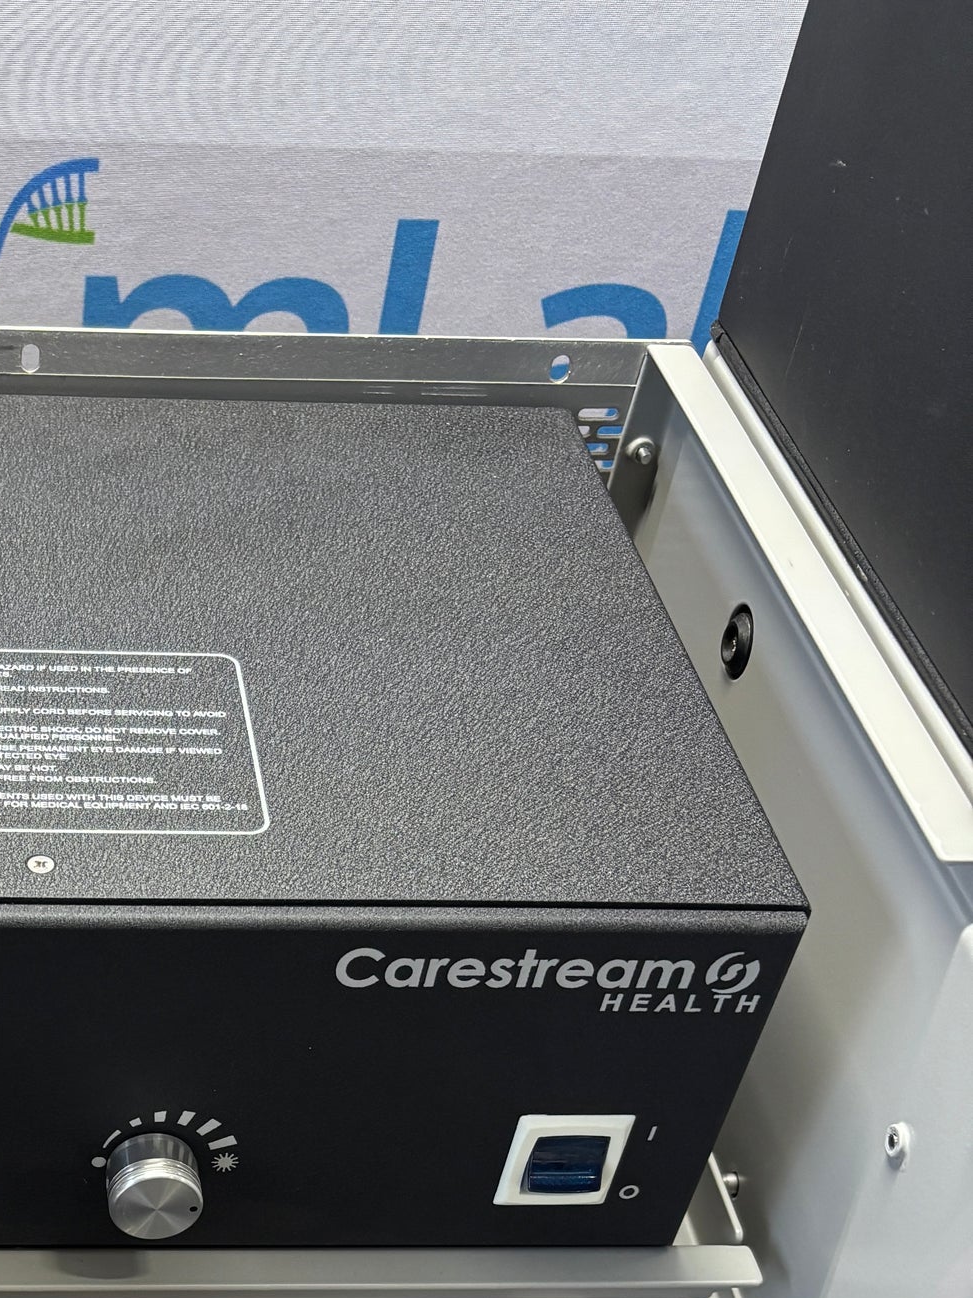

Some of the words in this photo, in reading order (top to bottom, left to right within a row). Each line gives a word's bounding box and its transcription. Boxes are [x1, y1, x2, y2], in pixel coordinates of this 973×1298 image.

[28, 686, 110, 694] INSTRUCTIONS.
[114, 709, 174, 717] SERVICING
[193, 710, 227, 718] AVOID
[104, 727, 127, 735] NOT
[179, 728, 221, 736] COVER.
[52, 734, 121, 742] PERSONNEL.
[19, 745, 89, 753] PERMANENT
[178, 747, 222, 755] VIEWED
[29, 775, 63, 783] FROM
[65, 776, 157, 784] OBSTRUCTIONS.
[66, 793, 96, 801] WITH
[126, 794, 168, 802] DEVICE
[205, 795, 222, 803] BE
[3, 800, 28, 808] FOR
[31, 801, 83, 809] MEDICAL
[84, 802, 151, 810] EQUIPMENT
[336, 947, 696, 989] Carestream
[599, 993, 761, 1014] HEALTH
